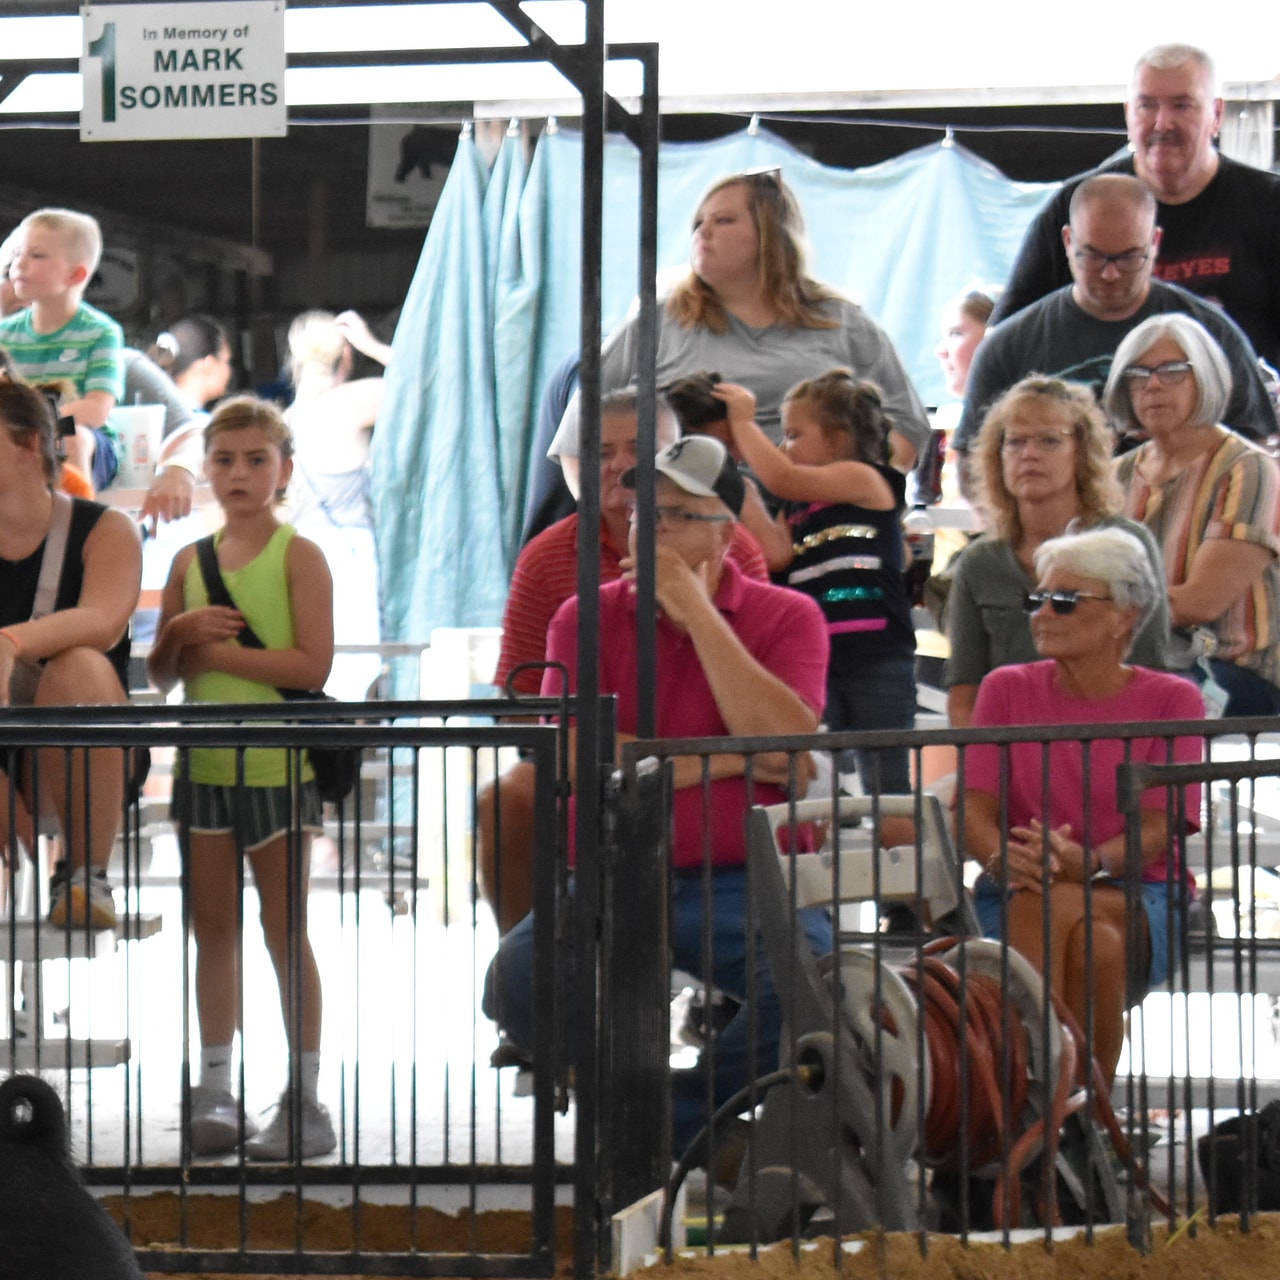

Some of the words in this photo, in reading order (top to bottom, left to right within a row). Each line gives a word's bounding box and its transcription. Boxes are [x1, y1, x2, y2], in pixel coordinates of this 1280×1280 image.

[143, 28, 157, 40] In
[163, 27, 228, 42] Memory
[233, 25, 249, 38] of
[88, 22, 116, 122] 1
[153, 47, 244, 73] MARK
[119, 82, 278, 110] SOMMERS
